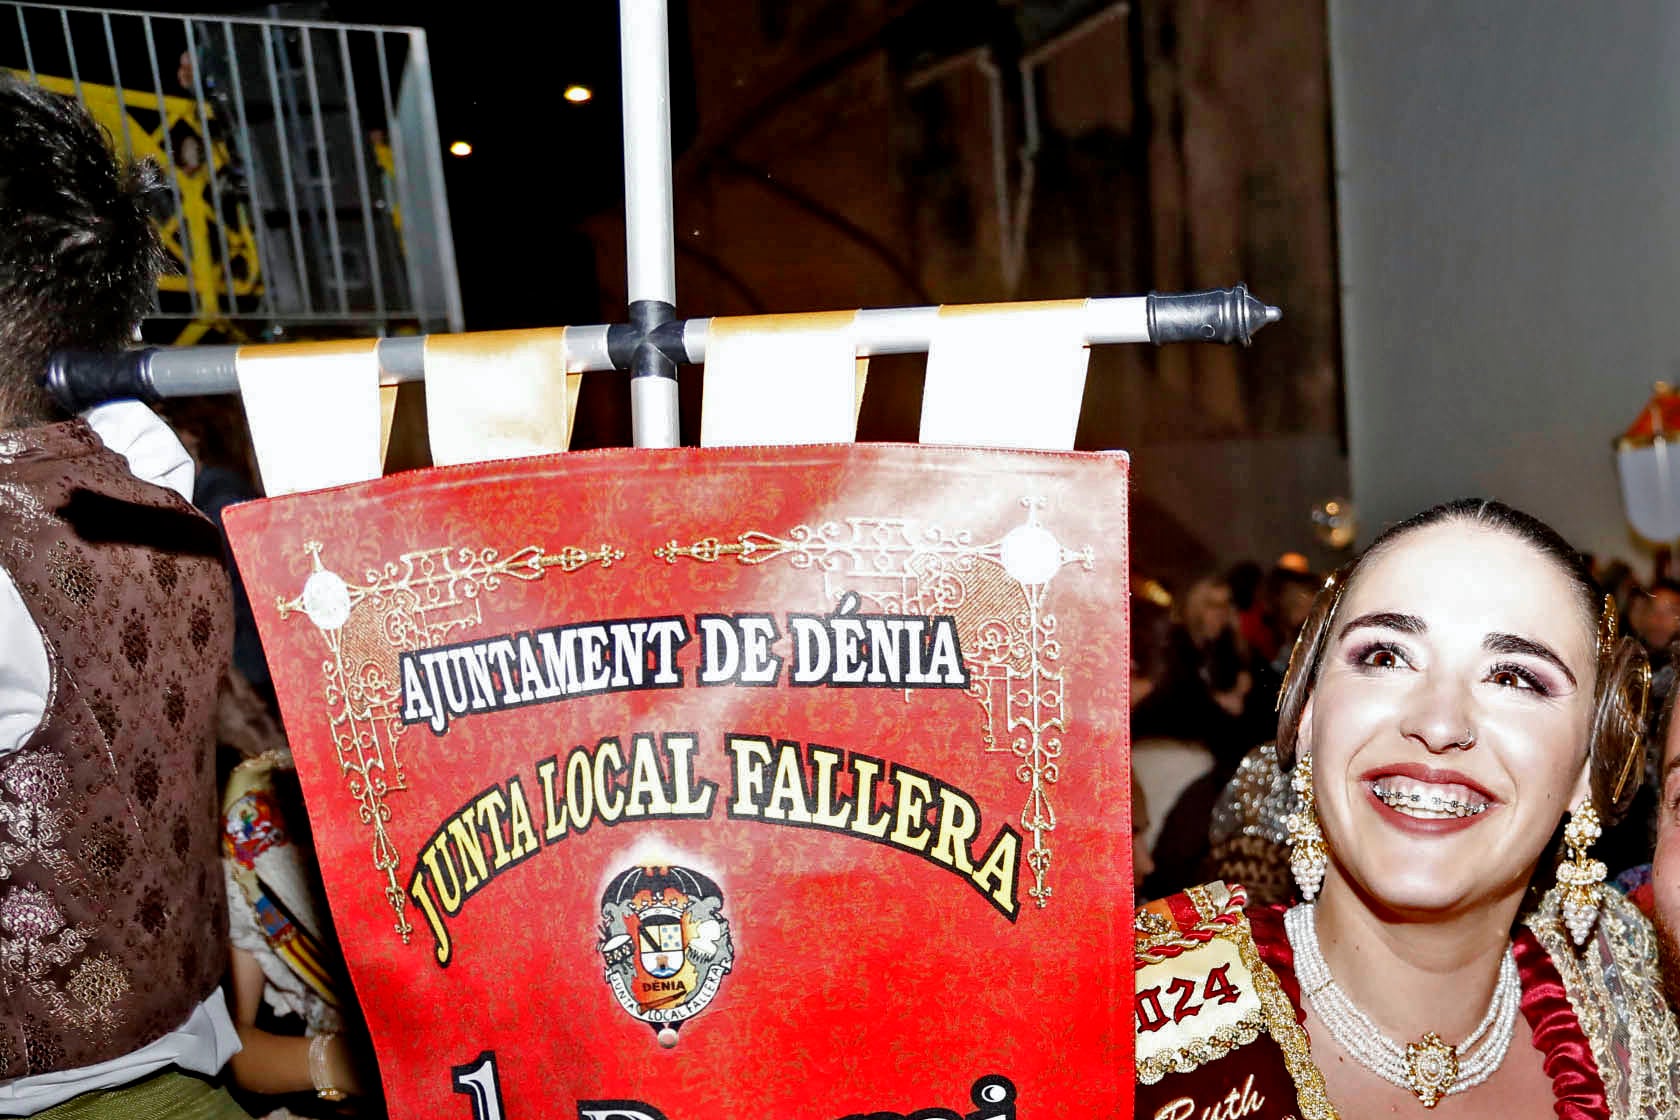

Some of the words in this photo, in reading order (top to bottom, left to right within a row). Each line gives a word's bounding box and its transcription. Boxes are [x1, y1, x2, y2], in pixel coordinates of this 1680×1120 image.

[400, 614, 687, 736] AJUNTAMENT
[696, 611, 778, 687] DE
[790, 591, 970, 690] DÉNIA
[409, 780, 541, 968] JUNTA
[535, 730, 719, 854] LOCAL
[725, 733, 1030, 923] FALLERA
[612, 973, 635, 1013] JUNTA
[648, 1008, 686, 1022] LOCAL
[686, 967, 722, 1014] FALLERA
[1135, 962, 1242, 1034] 024
